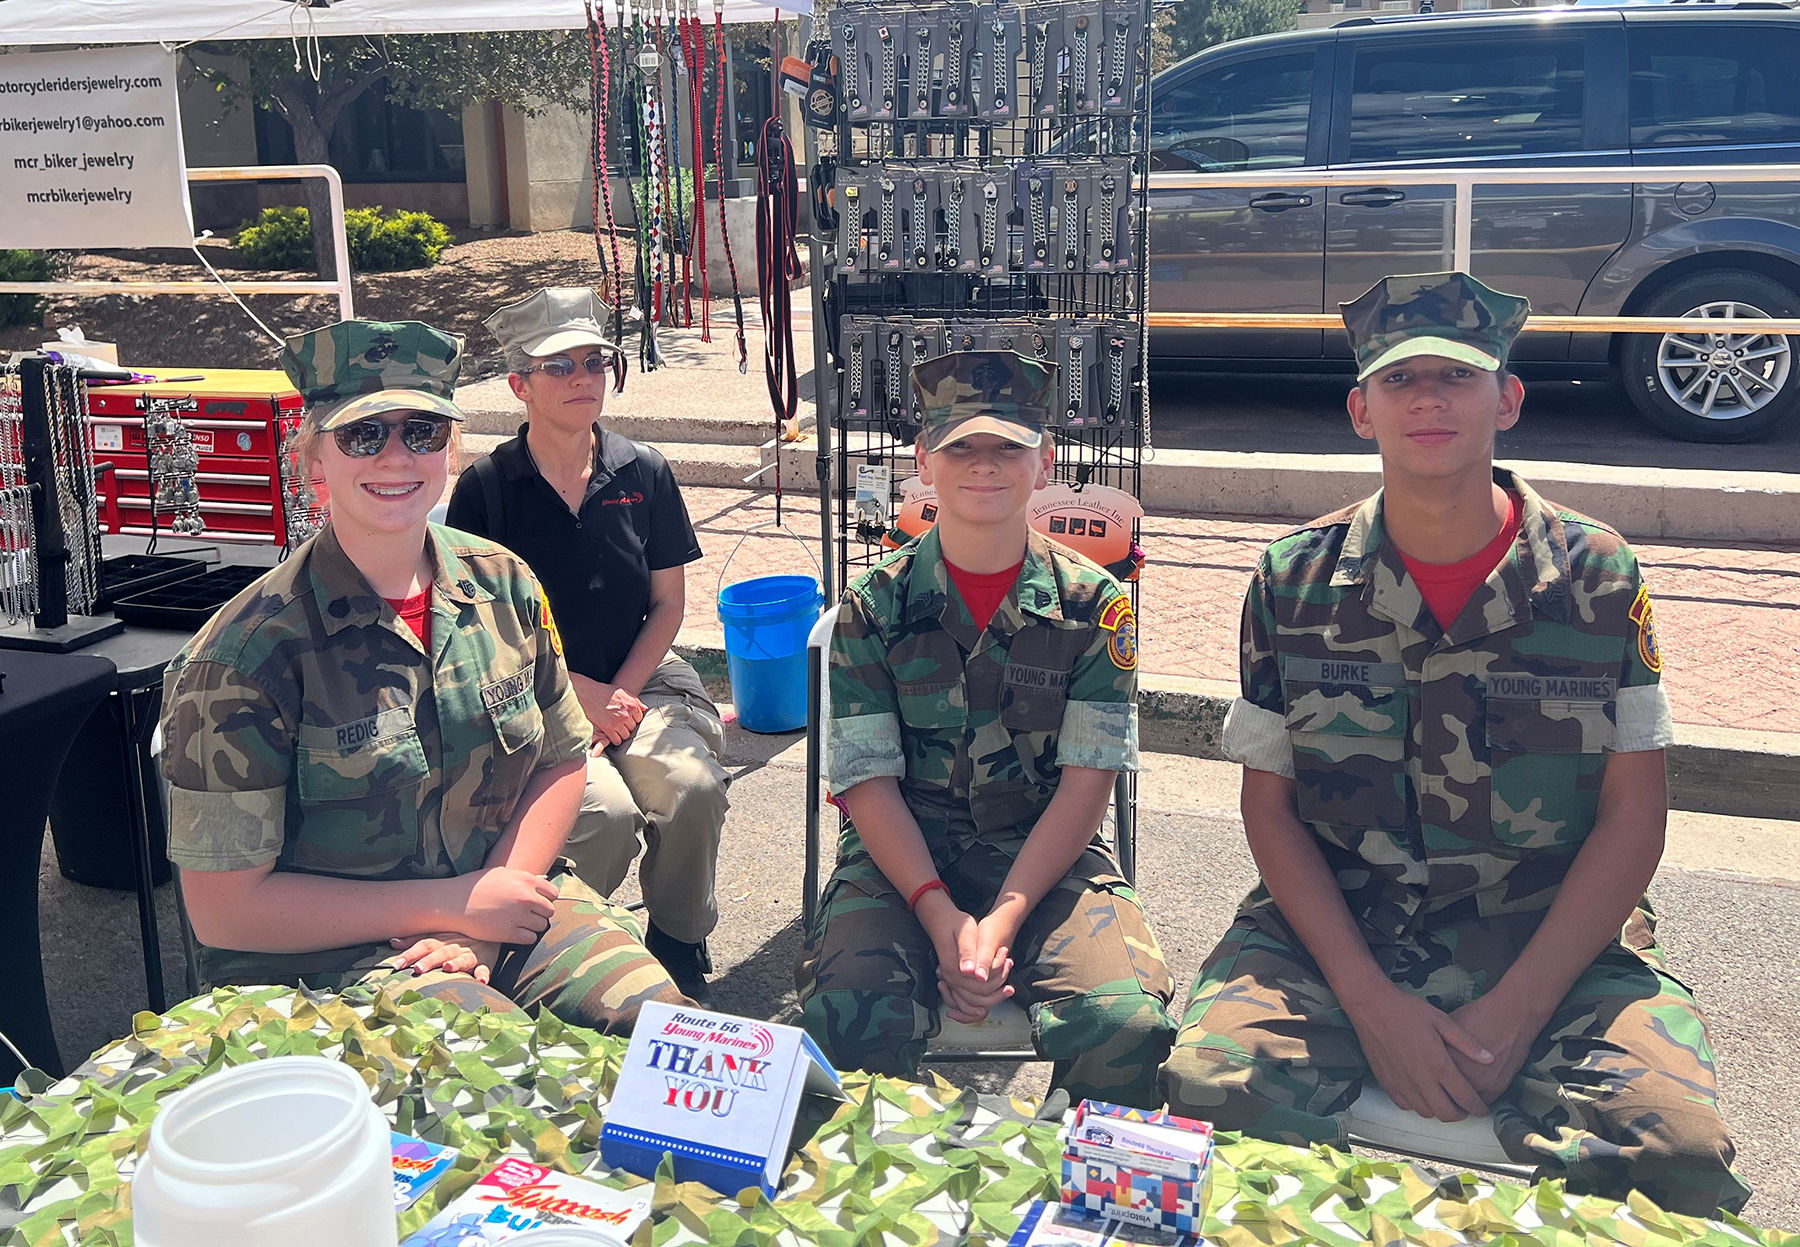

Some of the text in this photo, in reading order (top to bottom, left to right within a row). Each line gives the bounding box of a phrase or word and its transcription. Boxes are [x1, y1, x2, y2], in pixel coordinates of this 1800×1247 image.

[27, 188, 132, 204] mcrbikerjewelry
[1031, 498, 1125, 524] Tennessee Leather Inc
[1010, 666, 1046, 686] YOUNG
[1320, 662, 1369, 682] BURKE
[486, 675, 524, 704] YOUNG
[1491, 677, 1610, 698] YOUNG MARINES
[336, 720, 379, 746] REDIG
[660, 1022, 759, 1050] Young Marines
[670, 1012, 743, 1034] Route 66
[646, 1038, 772, 1092] THANK
[663, 1075, 739, 1118] YOU
